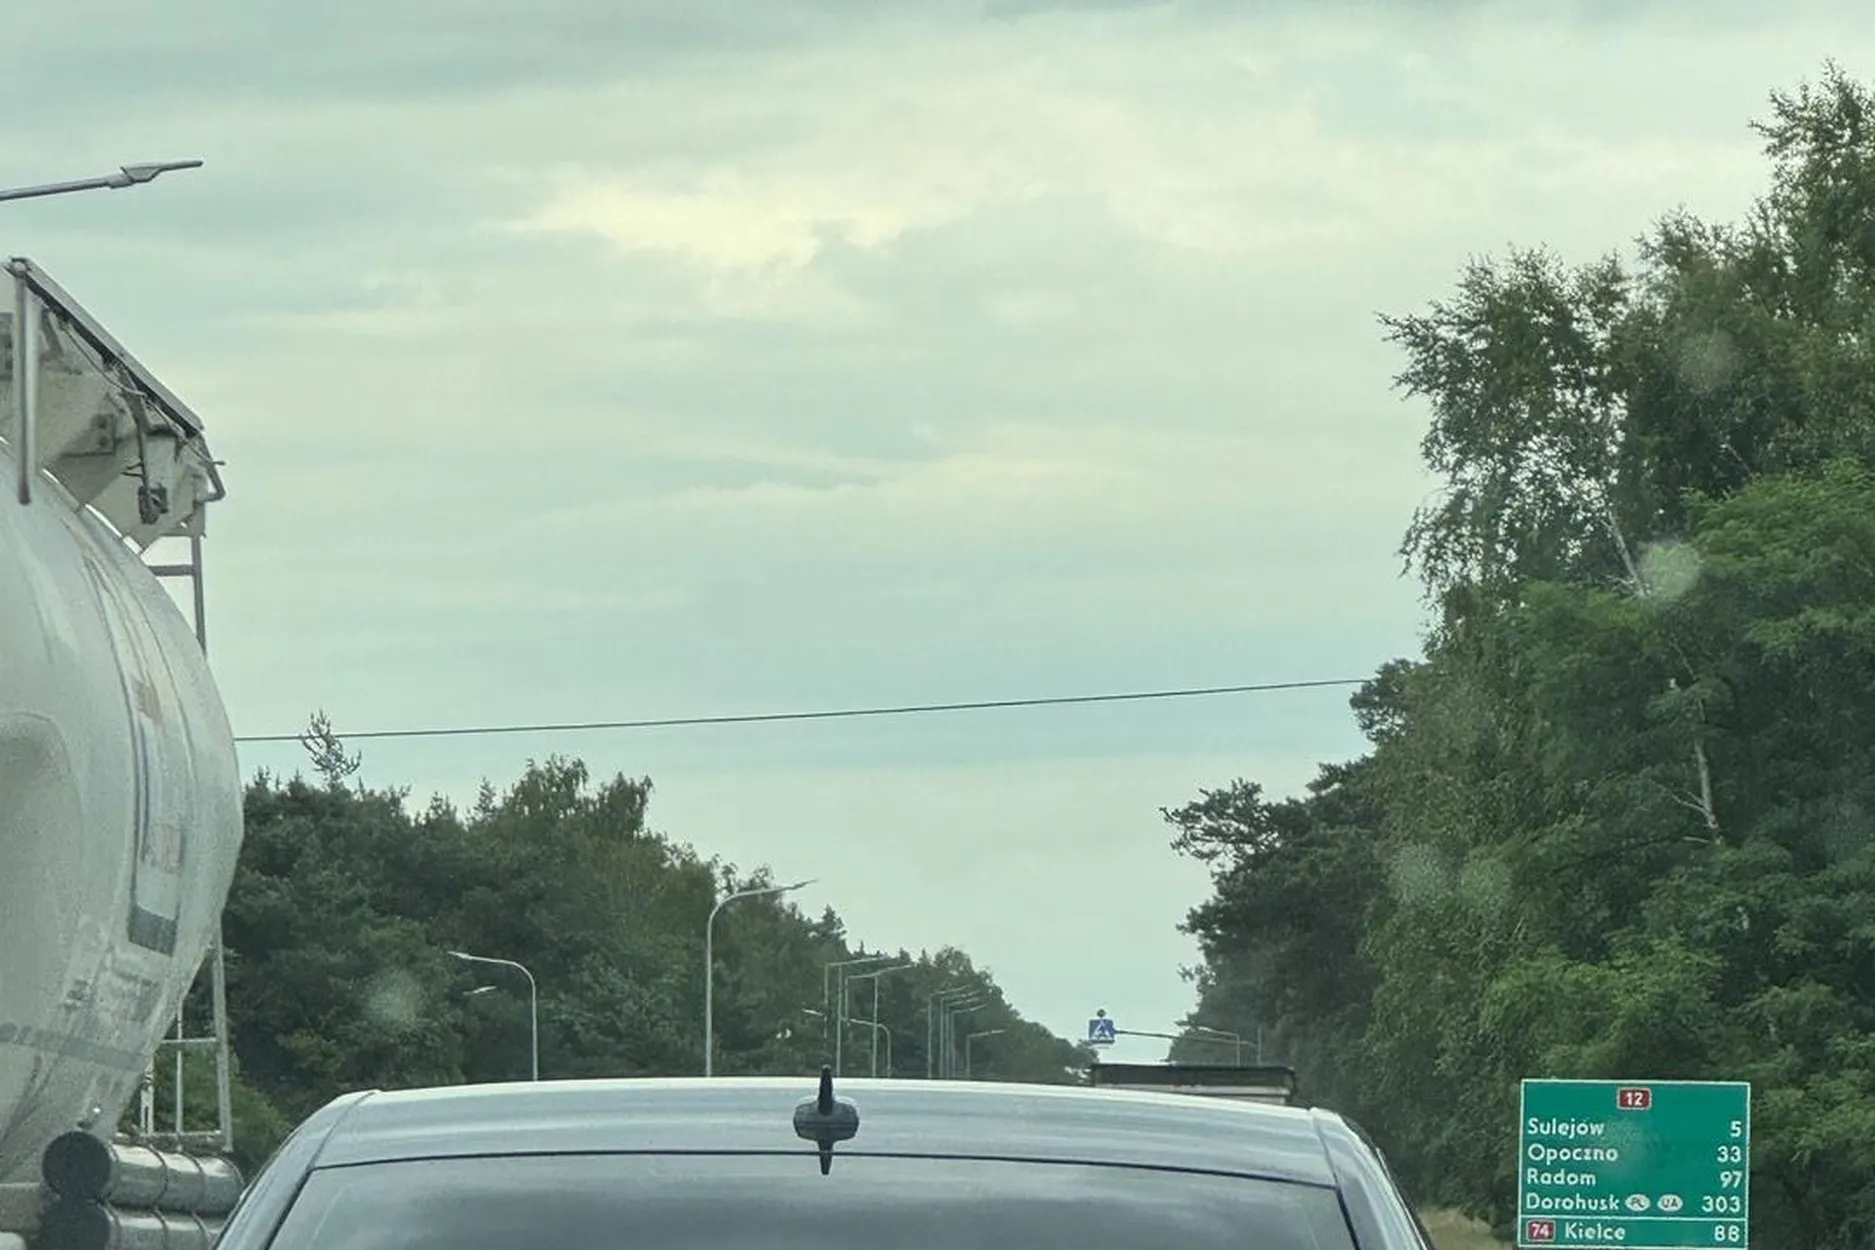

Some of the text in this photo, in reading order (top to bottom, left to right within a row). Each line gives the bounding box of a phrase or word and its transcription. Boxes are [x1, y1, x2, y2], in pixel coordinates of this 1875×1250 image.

[1626, 1091, 1643, 1106] 12
[1730, 1120, 1742, 1137] 5
[1528, 1143, 1741, 1166] Opoczno 33
[1527, 1168, 1742, 1188] Radom 97
[1526, 1192, 1620, 1210] Dorohusk
[1701, 1195, 1741, 1212] 303
[1531, 1222, 1740, 1242] 74 Kielce 88
